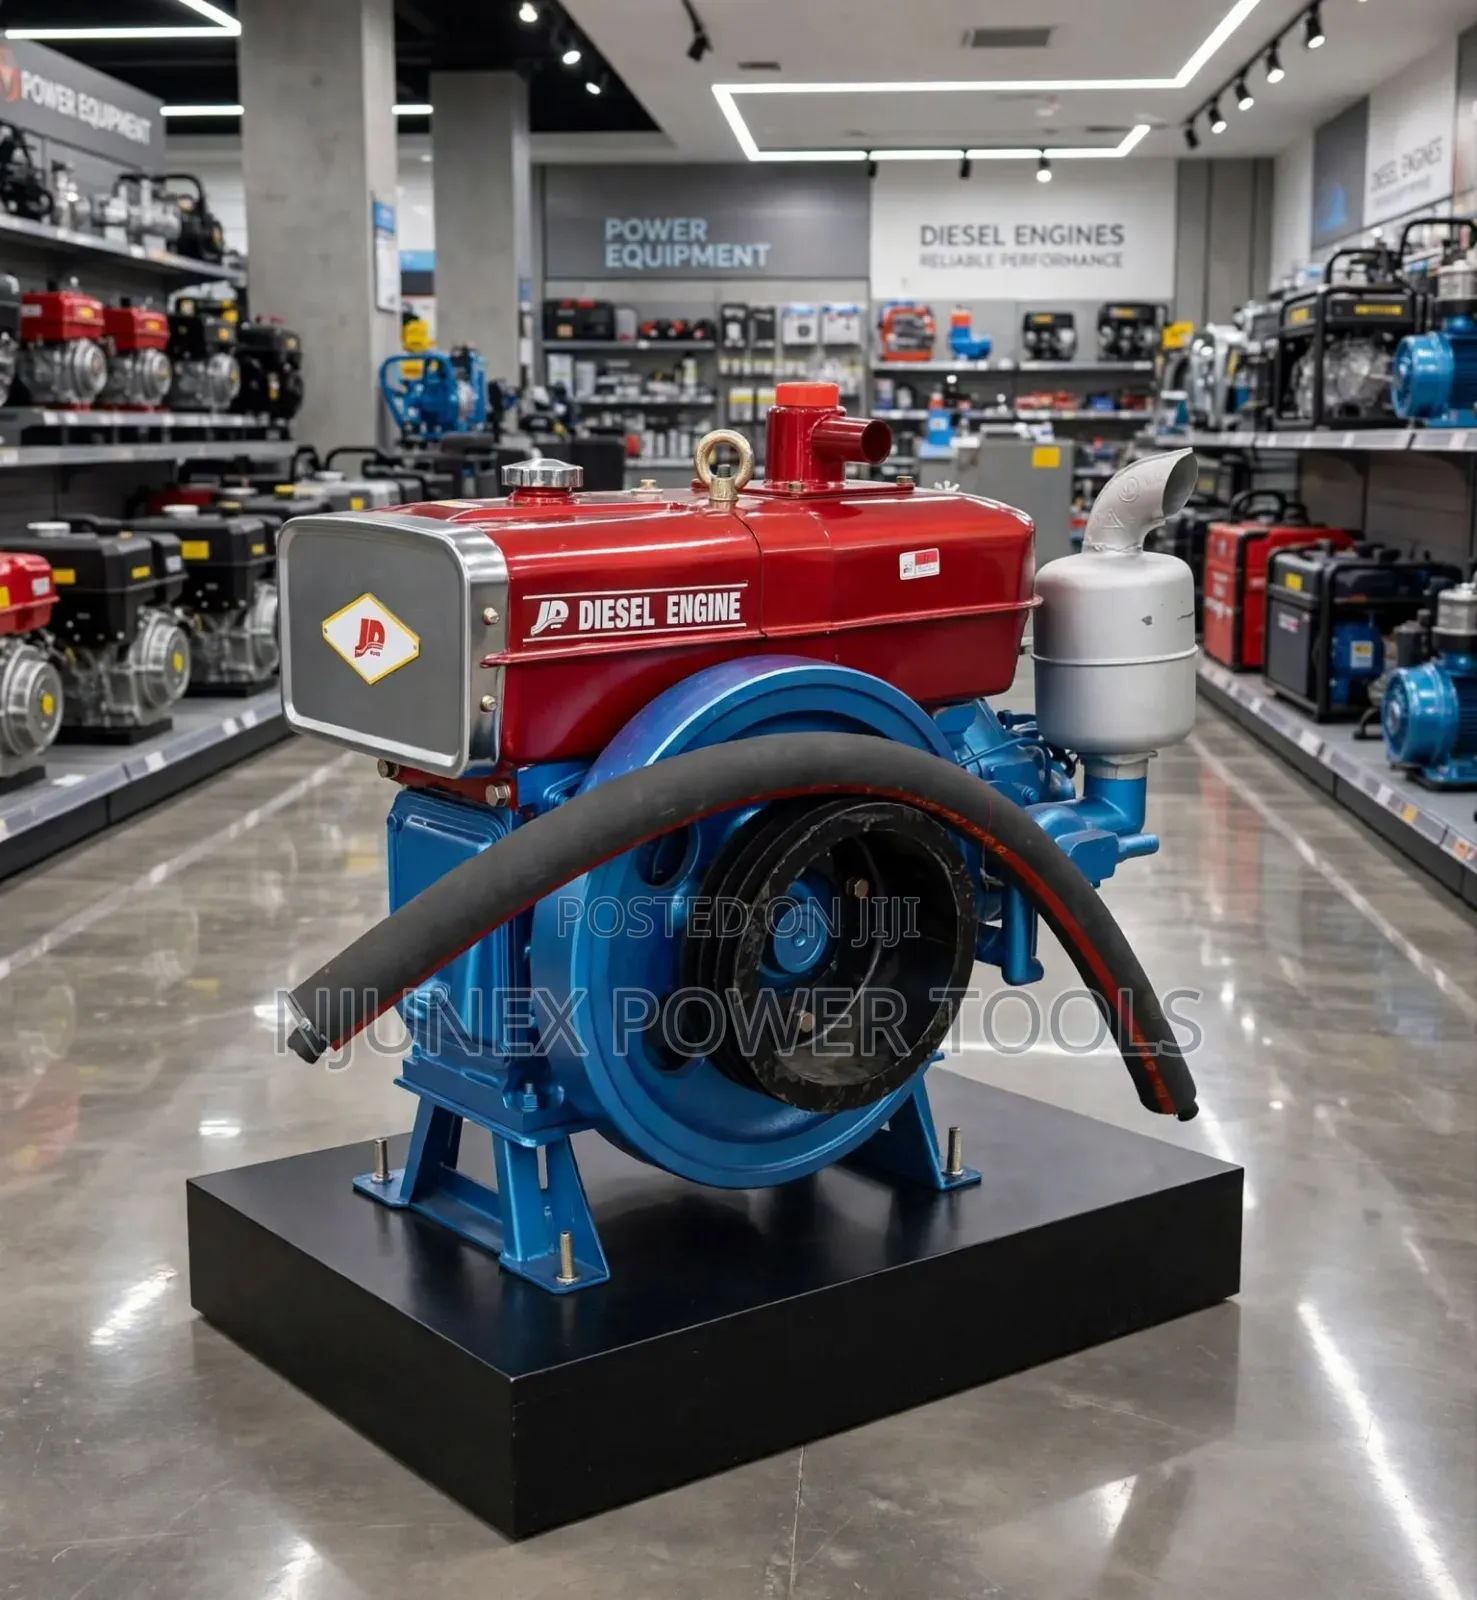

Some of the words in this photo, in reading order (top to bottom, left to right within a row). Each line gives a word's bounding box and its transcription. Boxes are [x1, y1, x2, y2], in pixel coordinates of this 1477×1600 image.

[21, 69, 77, 117] POWER
[77, 92, 151, 145] EQUIPMENT
[604, 217, 708, 242] POWER
[920, 224, 1005, 246] DIESEL
[1014, 224, 1125, 246] ENGINES
[604, 242, 771, 270] EQUIPMENT
[920, 252, 993, 268] RELIABLE
[999, 252, 1123, 268] PERFORMANCE
[578, 597, 655, 631] DIESEL
[666, 591, 741, 624] ENGINE
